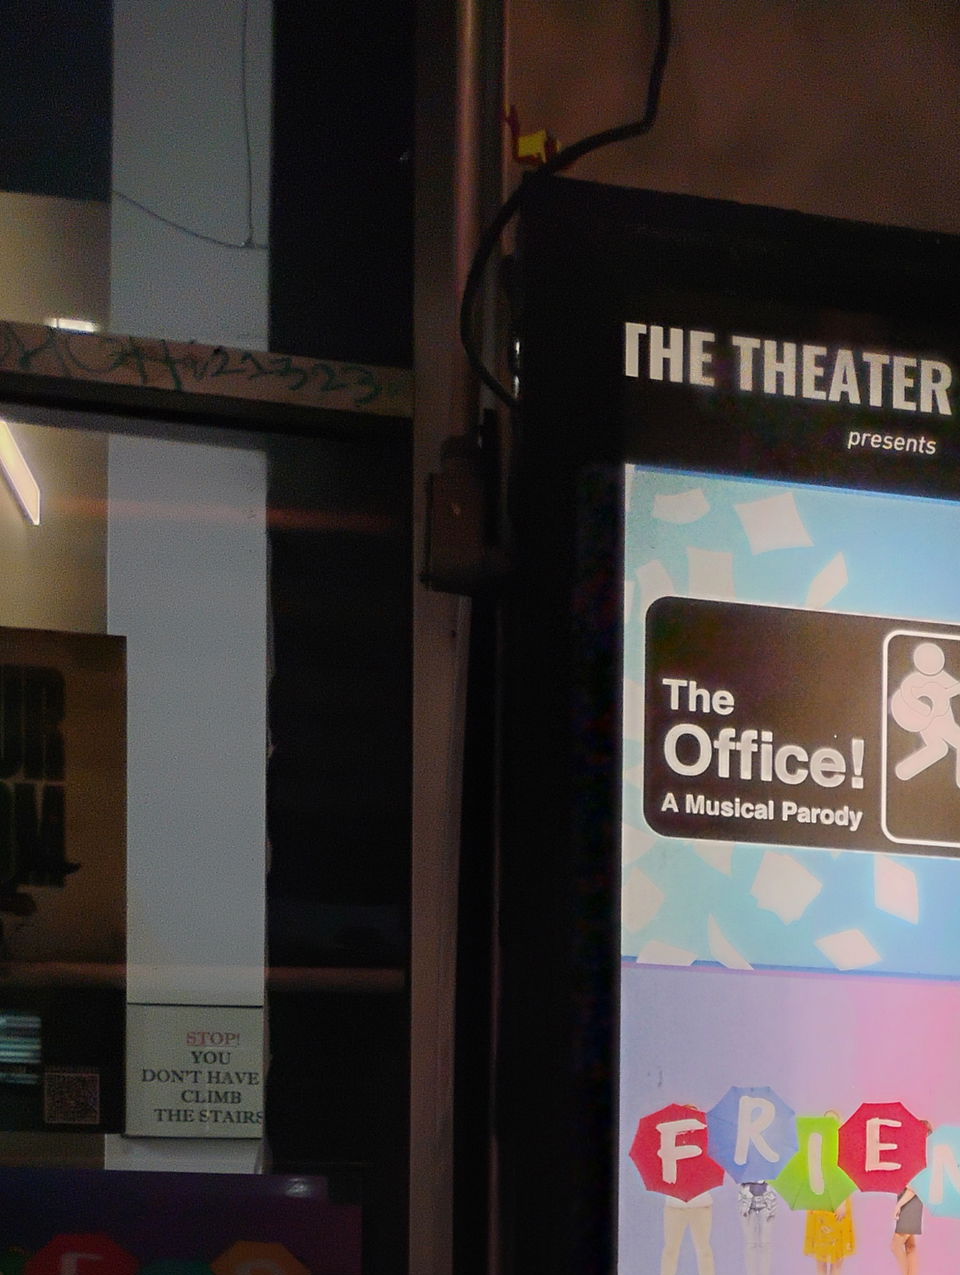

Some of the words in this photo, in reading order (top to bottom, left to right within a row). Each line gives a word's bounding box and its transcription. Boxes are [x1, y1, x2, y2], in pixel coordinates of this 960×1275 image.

[624, 322, 715, 387] THE
[732, 335, 953, 416] THEATER
[847, 428, 937, 456] presents
[662, 678, 735, 716] The
[663, 723, 865, 789] Office!
[661, 793, 679, 813] A
[685, 794, 774, 821] Musical
[782, 800, 863, 832] Parody
[186, 1031, 240, 1048] STOP!
[191, 1051, 231, 1065] YOU
[142, 1069, 202, 1083] DON'T
[207, 1071, 259, 1085] HAVE
[181, 1090, 242, 1104] CLIMB
[154, 1108, 194, 1122] THE
